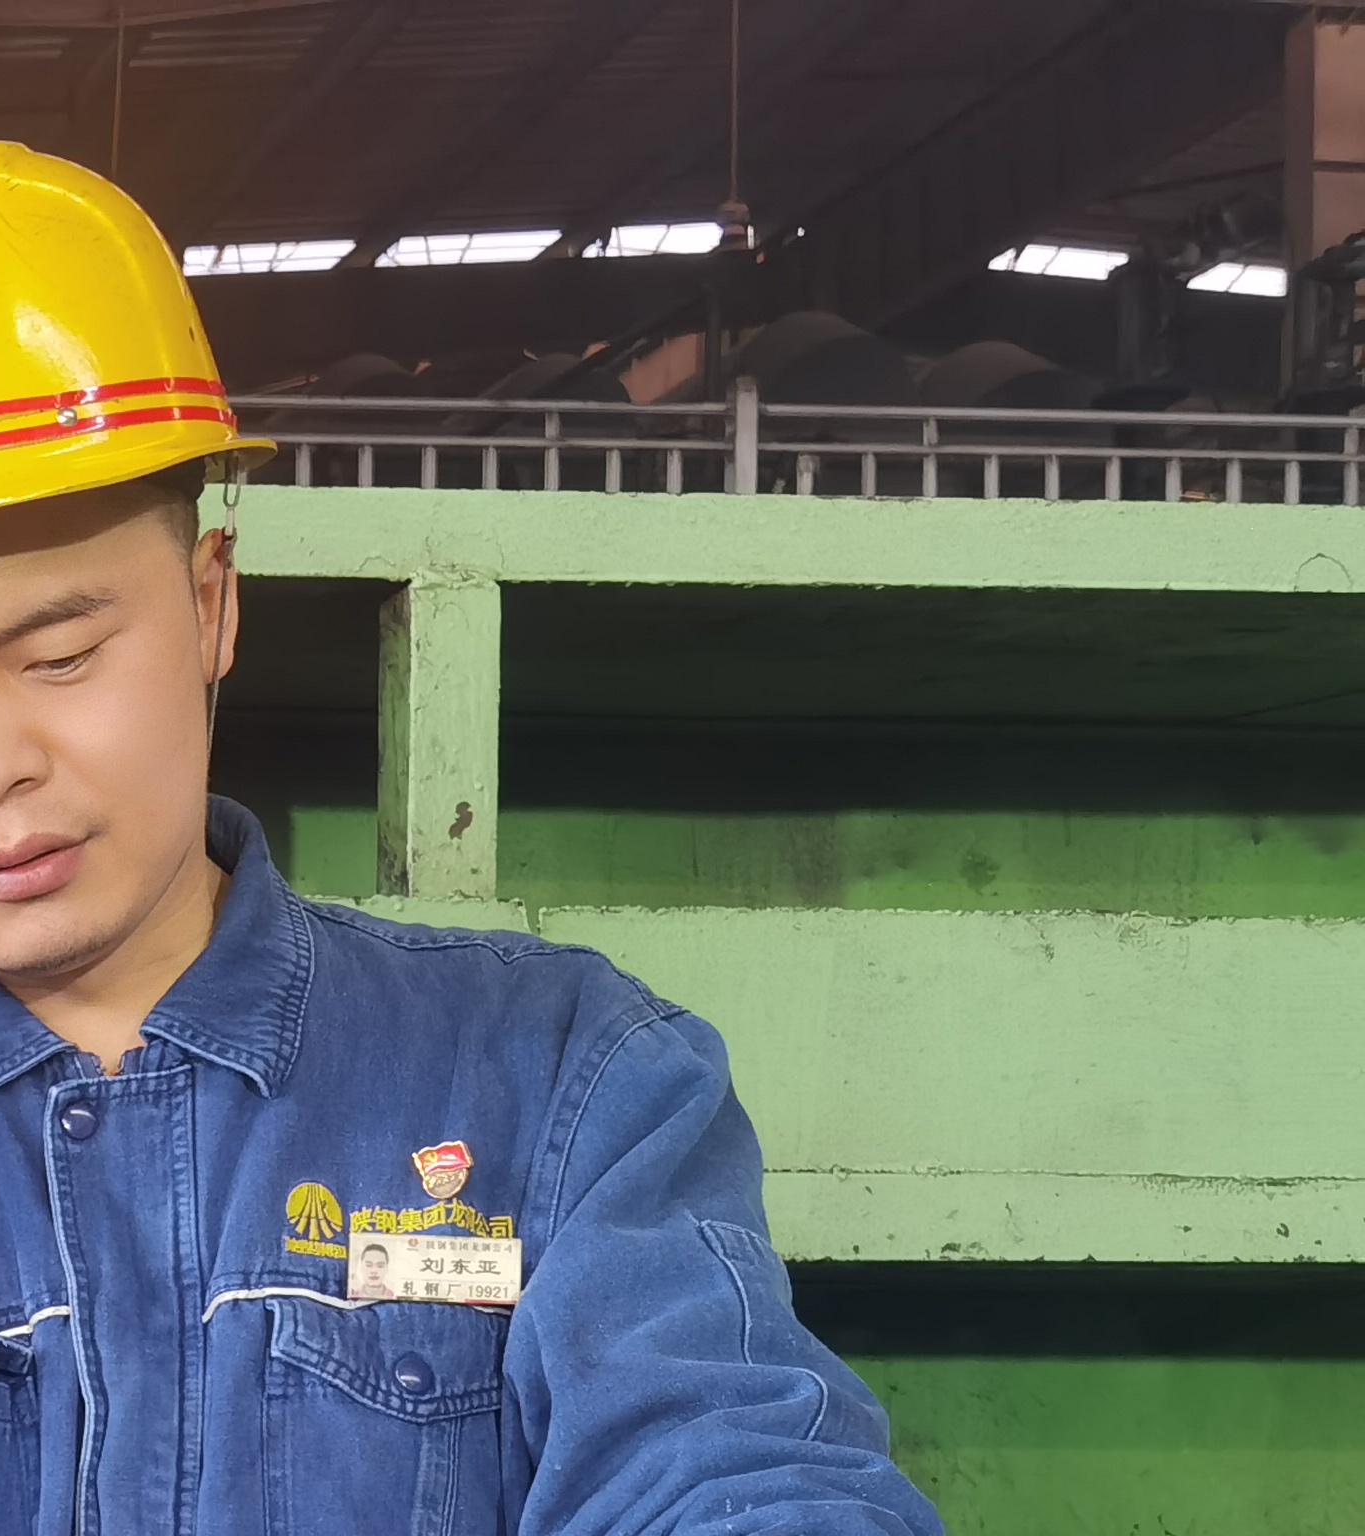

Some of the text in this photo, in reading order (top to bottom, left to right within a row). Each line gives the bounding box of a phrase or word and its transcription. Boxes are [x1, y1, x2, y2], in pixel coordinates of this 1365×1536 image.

[419, 1257, 502, 1275] 刘东亚
[401, 1281, 509, 1299] 轧钢厂 19921
